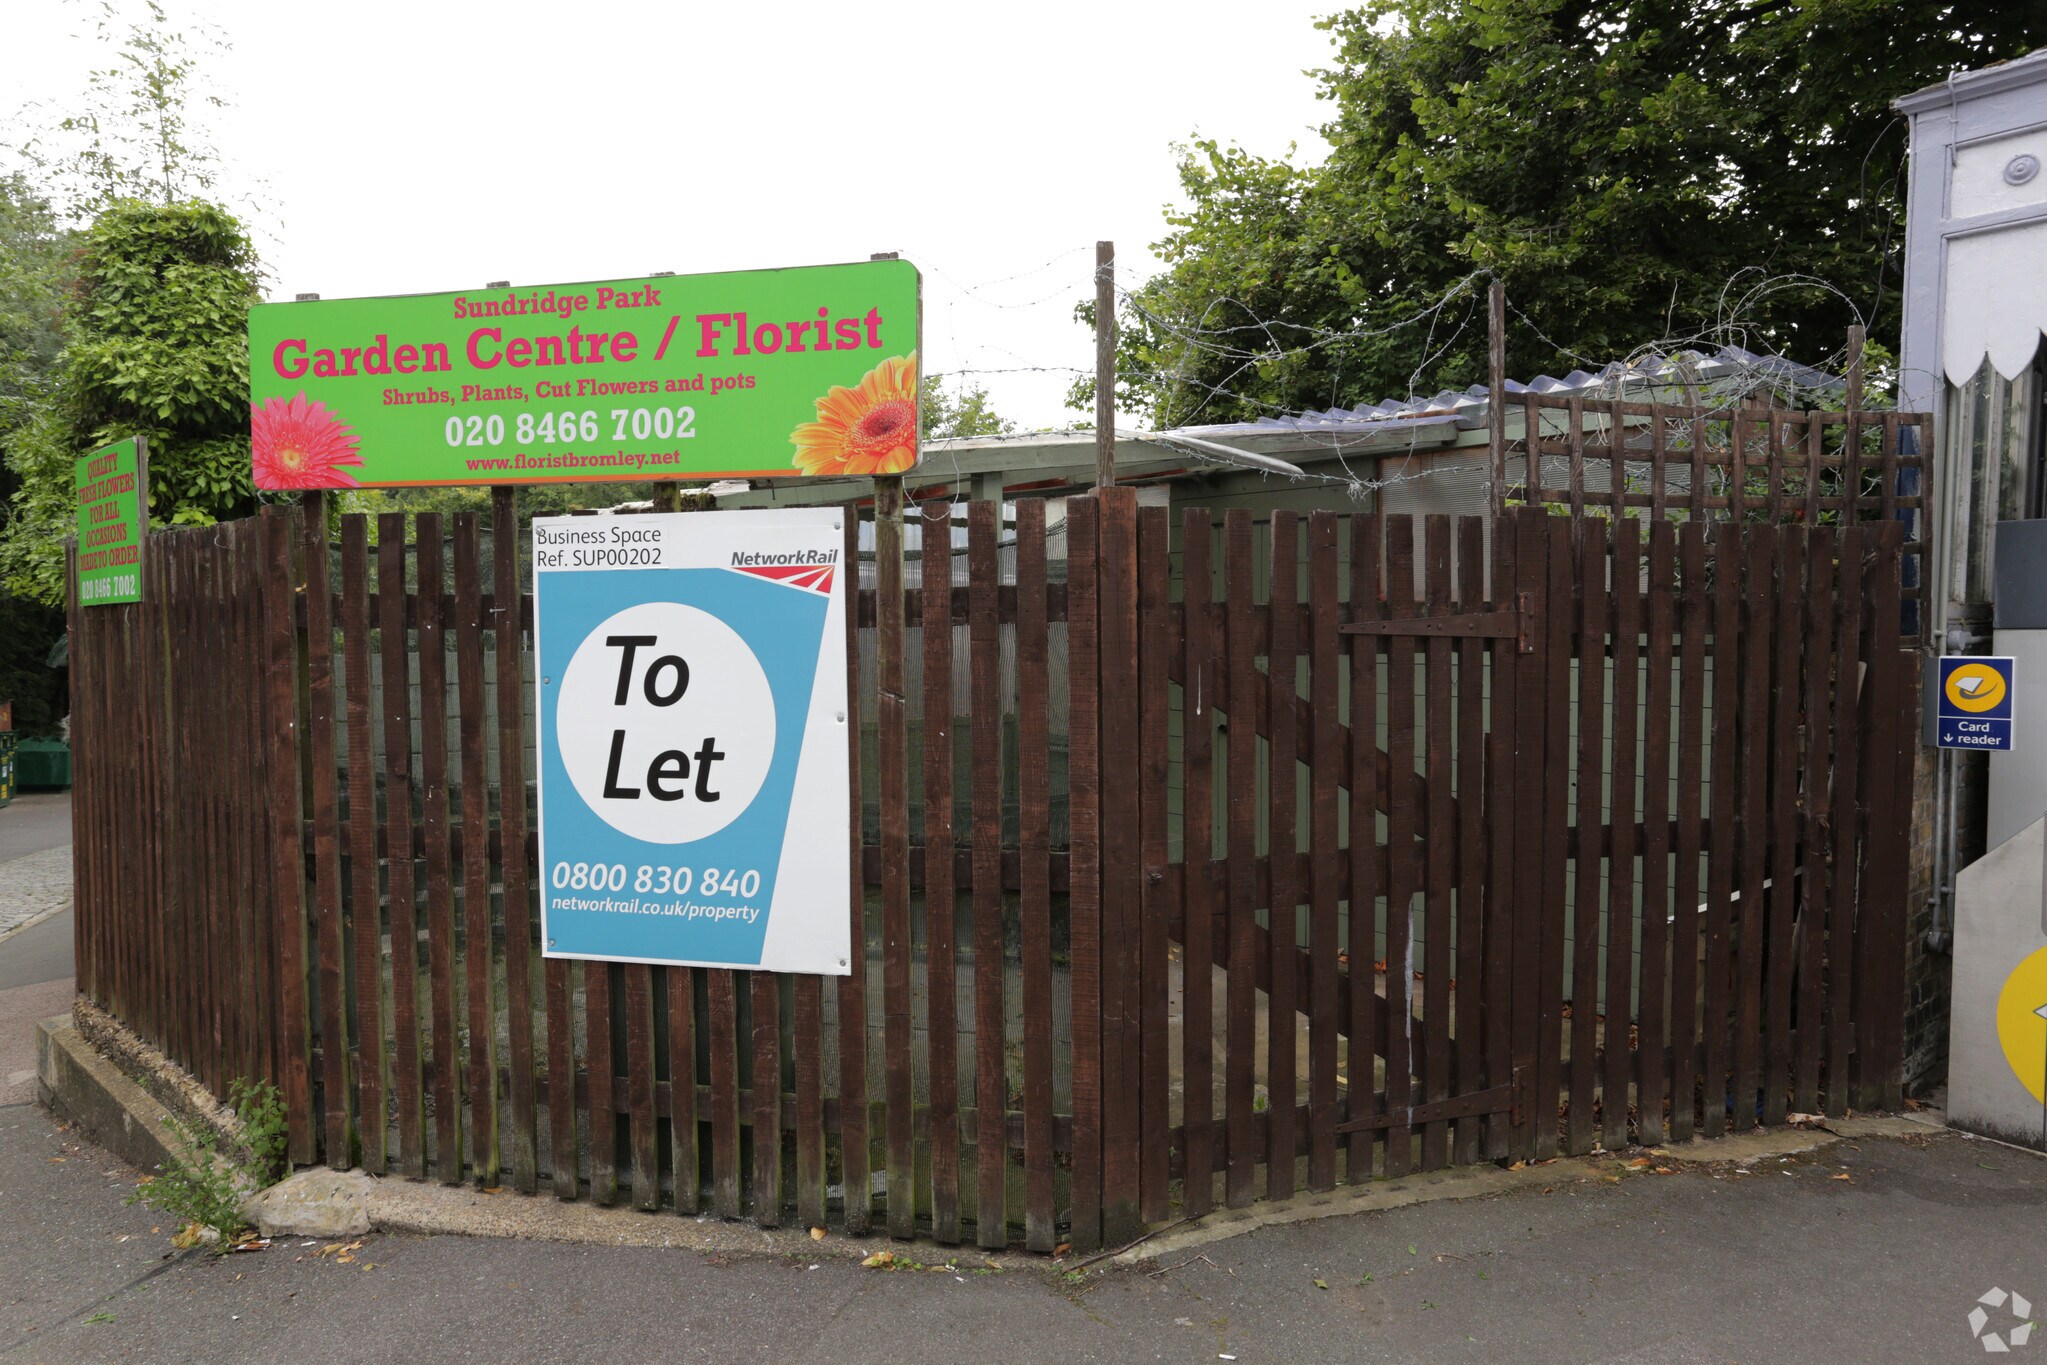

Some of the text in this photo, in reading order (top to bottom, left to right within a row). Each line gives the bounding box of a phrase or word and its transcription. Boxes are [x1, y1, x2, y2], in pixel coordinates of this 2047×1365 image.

[453, 284, 662, 319] Sundridge Park
[272, 307, 883, 379] Garden Centre / Florist
[383, 373, 756, 406] Shrubs, Plants, Cut Flowers and pots
[445, 405, 696, 447] 020 8466 7002
[87, 452, 118, 481] QUALITY
[466, 449, 681, 473] www.floristbromley.net
[78, 472, 134, 505] FRESH FLOWERS
[89, 501, 119, 524] FOR ALL
[86, 523, 127, 547] OCCASIONS
[537, 526, 662, 548] Business Space
[109, 545, 138, 566] ORDER
[537, 547, 662, 567] Ref. SUP00202
[731, 549, 839, 567] NetworkRail
[82, 574, 135, 599] 020 8466 7002
[605, 635, 690, 708] To
[1958, 721, 1990, 732] Card
[1958, 734, 2002, 745] reader
[602, 729, 726, 803] Let
[552, 861, 761, 898] 0800 830 840
[552, 896, 760, 924] networkrail.co.uk/property
